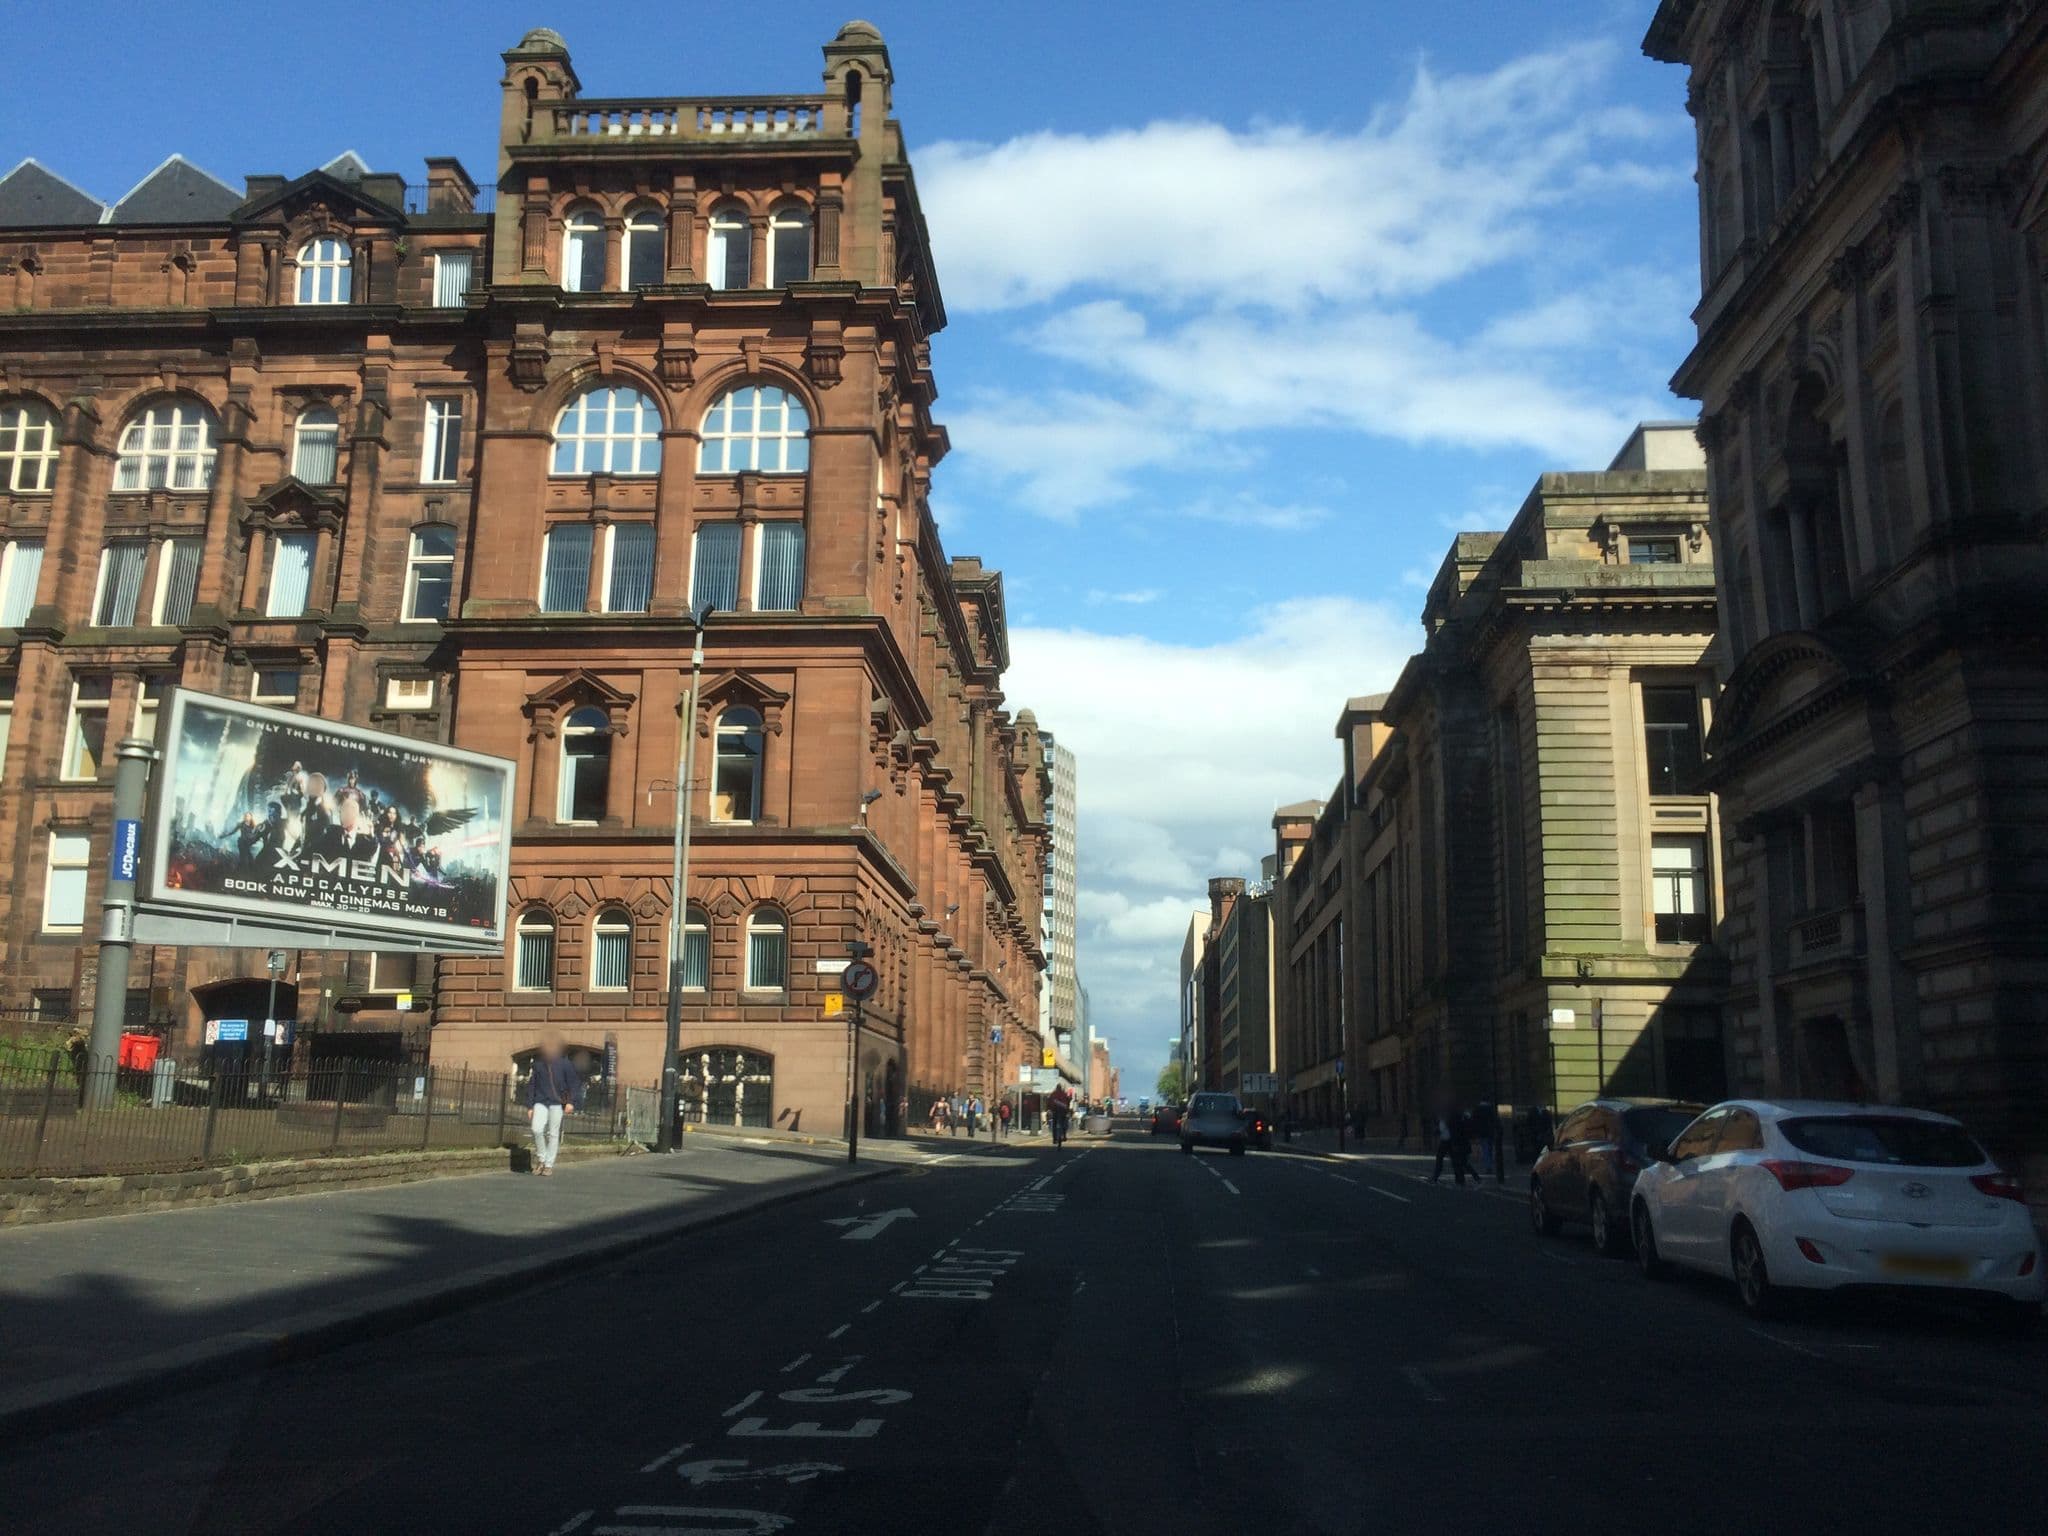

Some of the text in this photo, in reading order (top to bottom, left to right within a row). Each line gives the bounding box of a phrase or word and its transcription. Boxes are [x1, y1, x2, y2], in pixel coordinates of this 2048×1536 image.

[246, 719, 280, 733] ONLY
[286, 727, 310, 740] THE
[315, 734, 366, 752] STRONG
[371, 746, 398, 759] WILL
[121, 822, 137, 878] JCDecaux
[273, 847, 412, 888] X-MEN
[224, 878, 268, 894] BOOK
[272, 885, 307, 899] NOW
[320, 892, 335, 903] IN
[340, 895, 400, 911] CINEMAS
[405, 904, 430, 915] MAY
[433, 907, 447, 917] 18
[273, 873, 409, 901] APOCALYPSE
